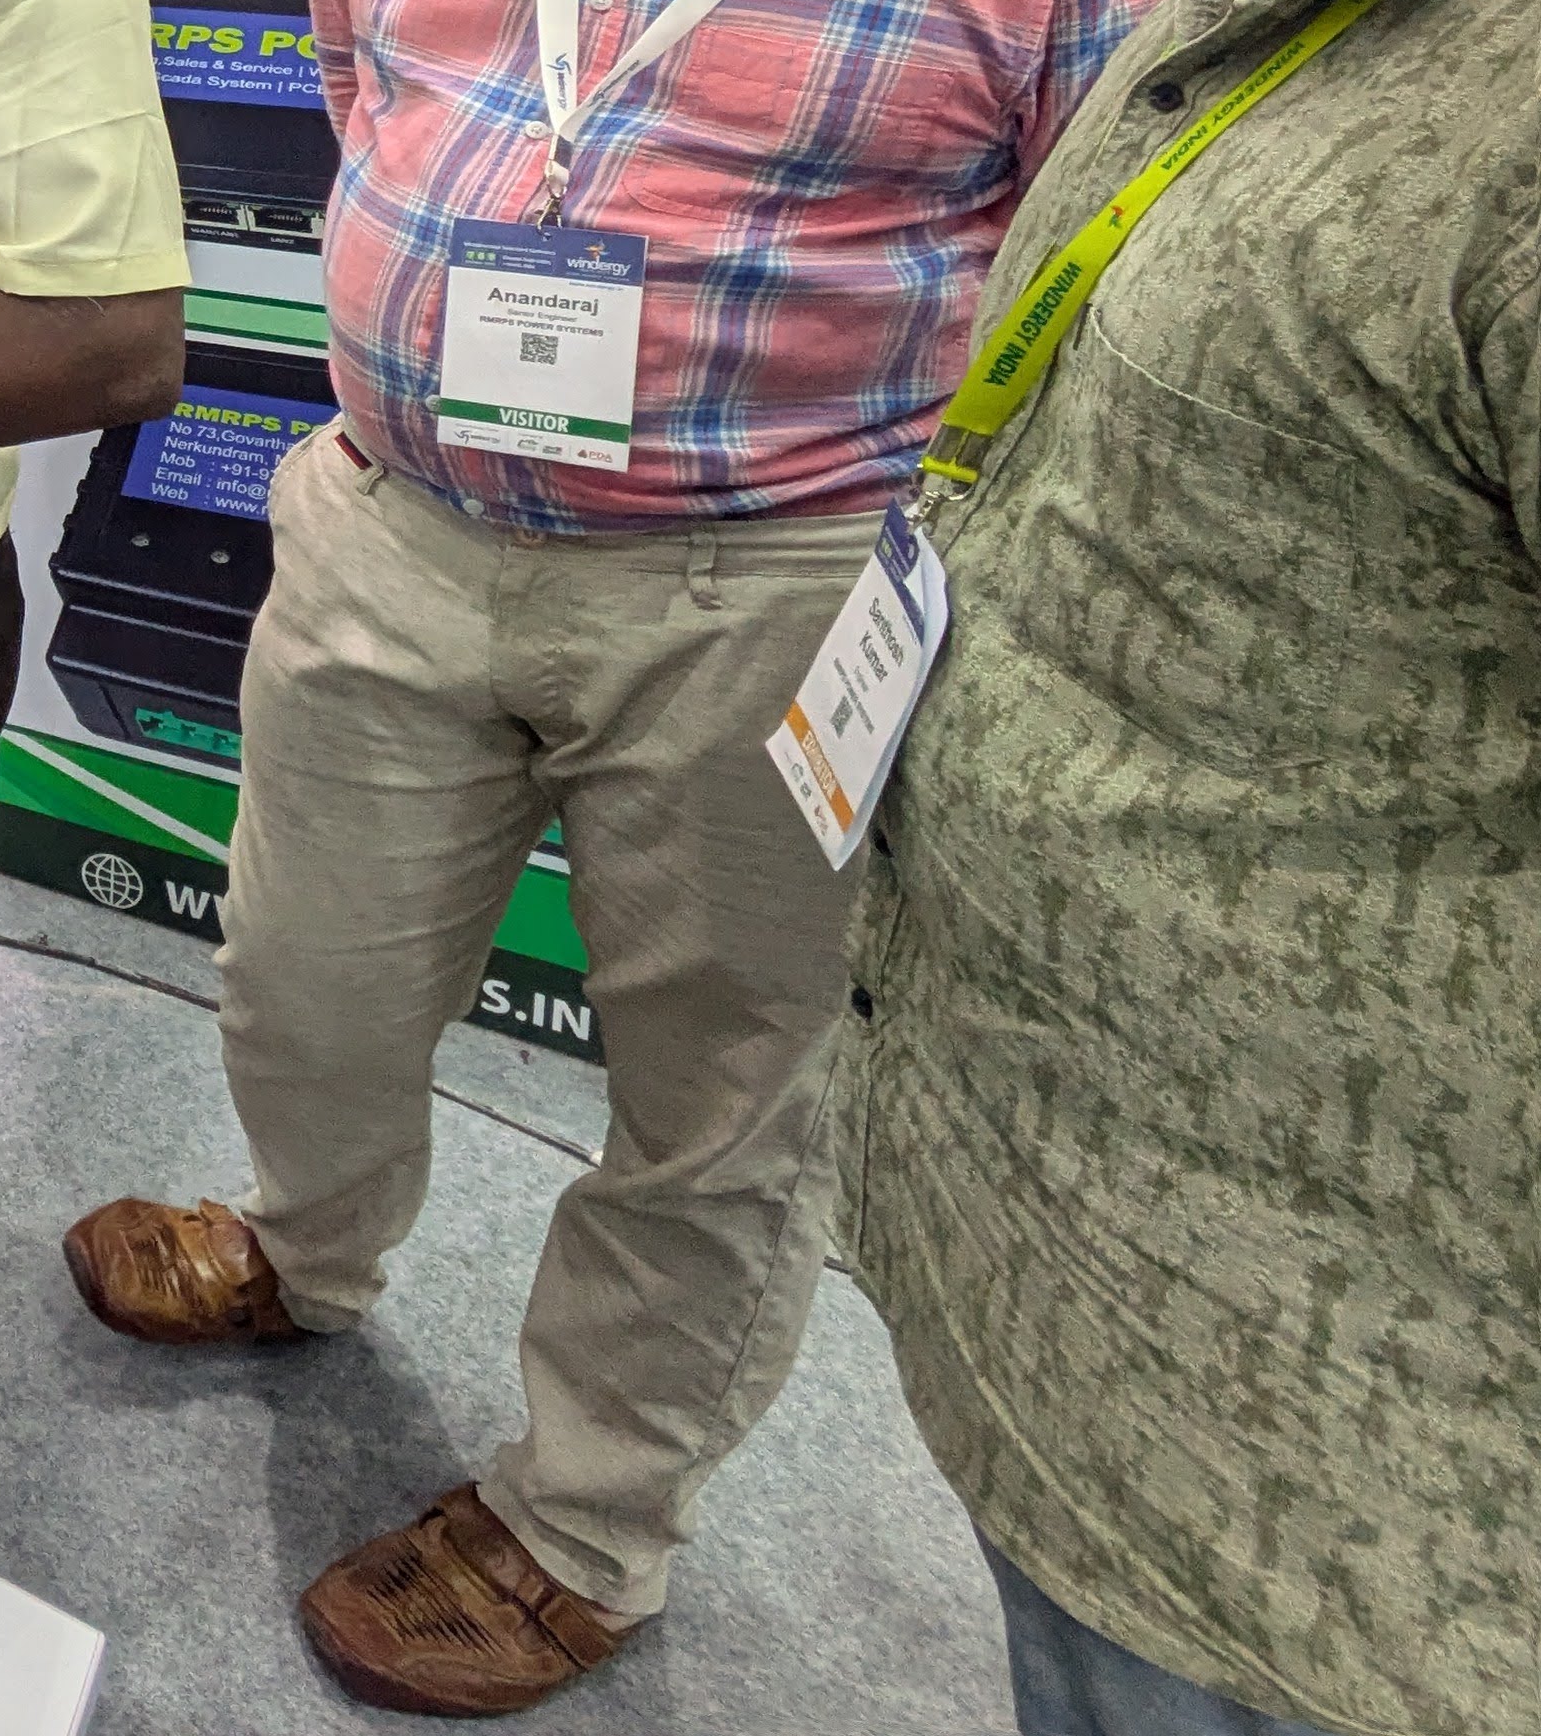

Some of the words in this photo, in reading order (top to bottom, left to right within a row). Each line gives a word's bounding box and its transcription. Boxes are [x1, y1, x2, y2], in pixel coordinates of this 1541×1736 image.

[212, 59, 225, 70] &
[230, 61, 294, 76] Service
[207, 75, 273, 91] System
[1210, 40, 1307, 127] WINDERGY
[1159, 124, 1211, 172] INDIA
[566, 255, 632, 276] windergy
[487, 287, 600, 317] Anandaraj
[1015, 261, 1084, 348] WINDERGY
[982, 340, 1030, 388] INDIA
[169, 420, 193, 436] No
[173, 401, 281, 432] RMRPS
[498, 407, 569, 433] VISITOR
[159, 449, 196, 469] Mob
[154, 465, 203, 487] Email
[150, 482, 190, 502] Web
[480, 978, 593, 1043] S.IN
